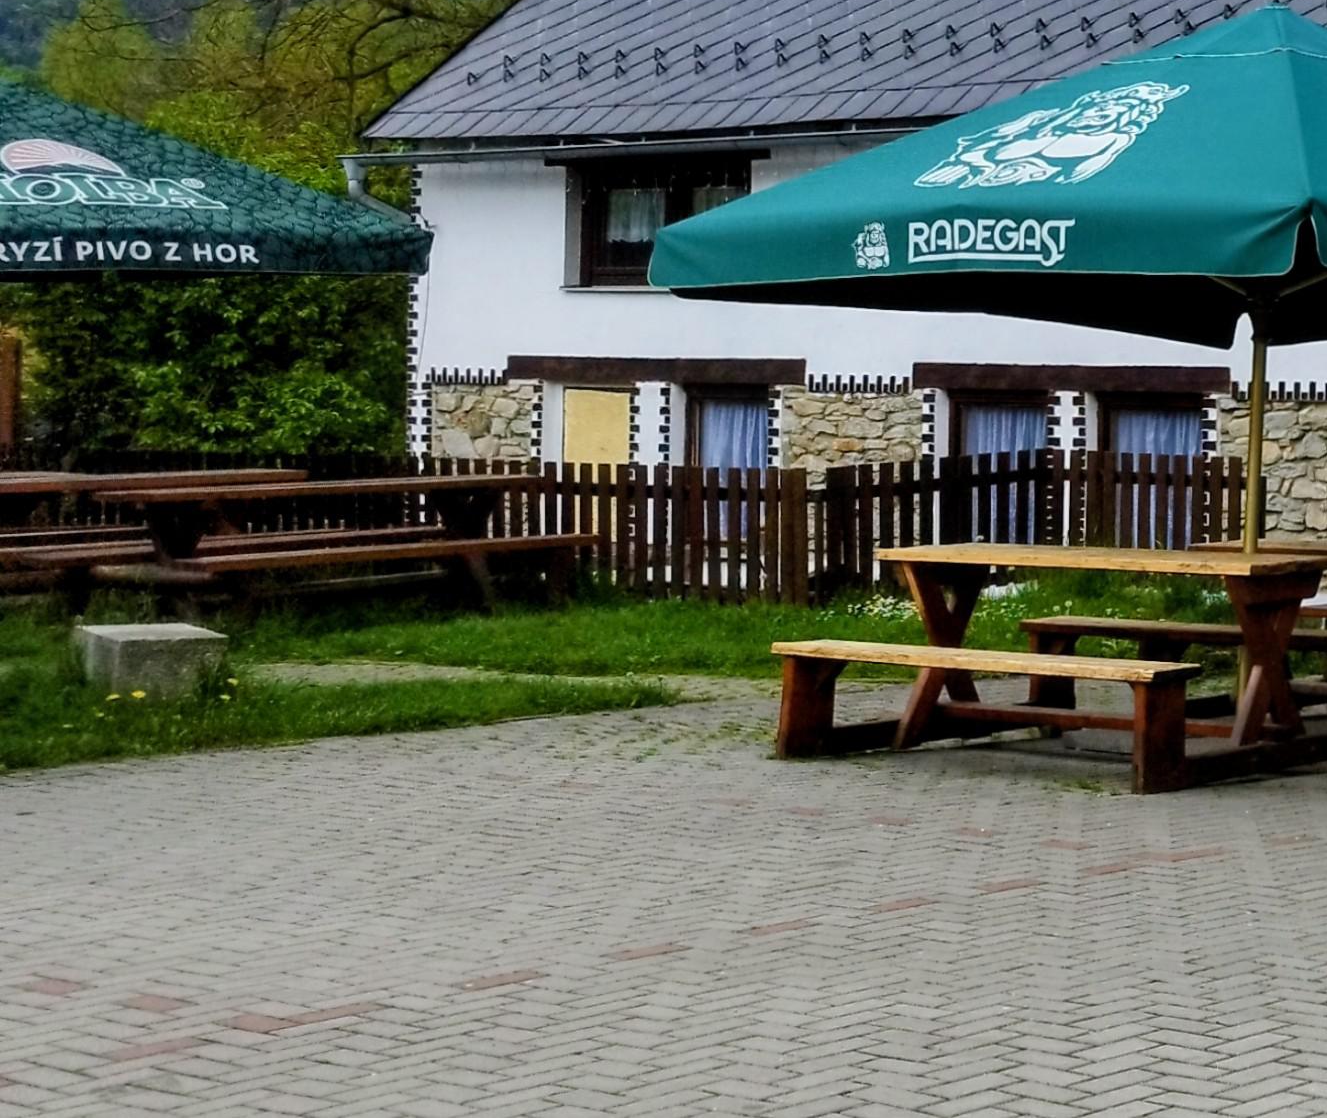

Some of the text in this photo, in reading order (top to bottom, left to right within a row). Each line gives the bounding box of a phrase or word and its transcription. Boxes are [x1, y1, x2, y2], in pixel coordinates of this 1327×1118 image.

[76, 240, 153, 261] PIVO
[164, 242, 182, 261] Z
[193, 242, 260, 265] HOR
[907, 218, 1076, 265] RADEGAST
